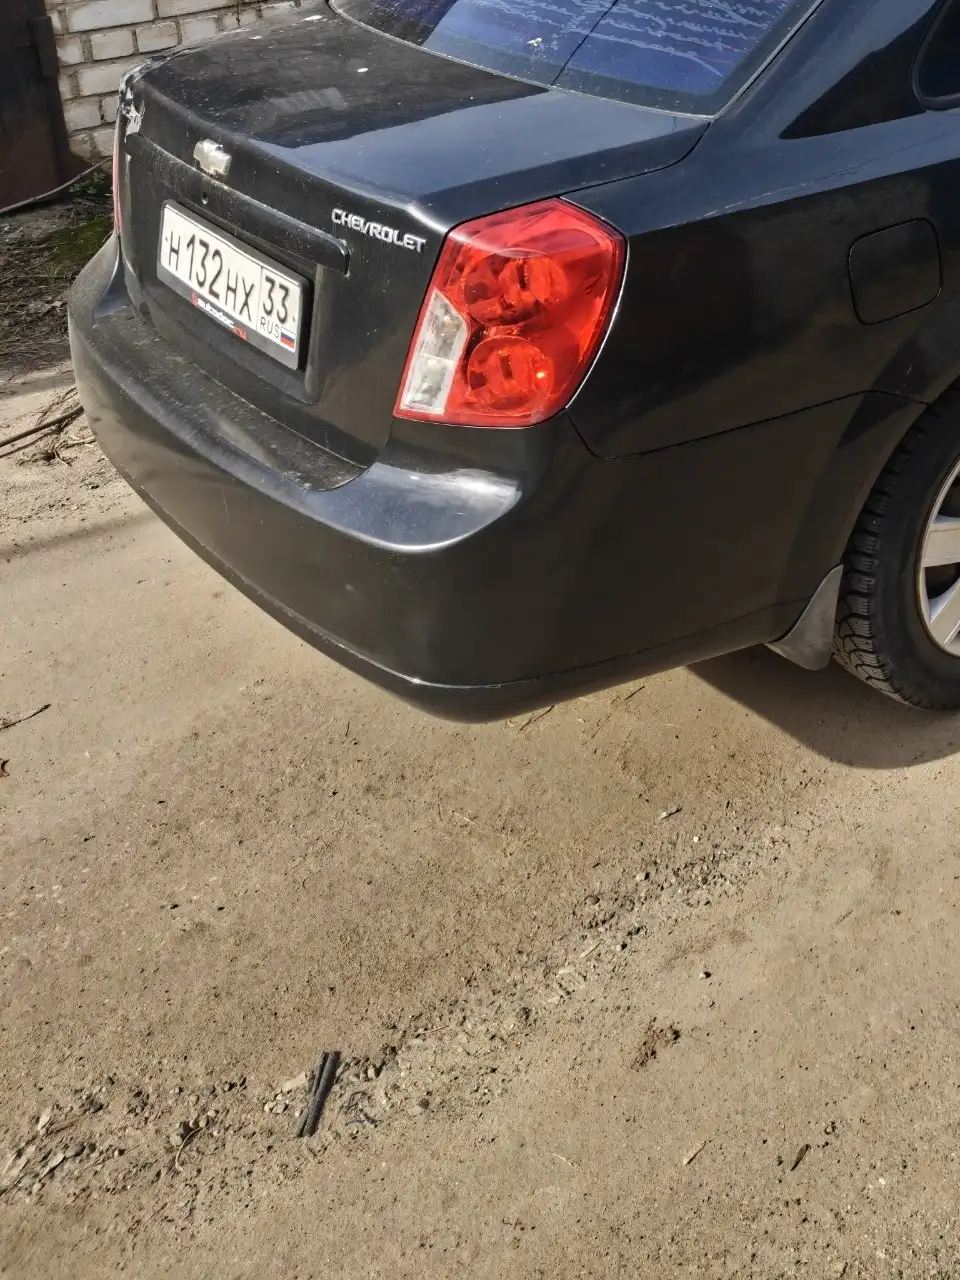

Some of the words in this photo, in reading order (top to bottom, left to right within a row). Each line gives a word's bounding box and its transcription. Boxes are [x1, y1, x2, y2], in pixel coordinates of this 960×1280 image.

[331, 208, 427, 253] CHEVROLET
[263, 275, 289, 324] 33
[260, 316, 280, 339] RUS
